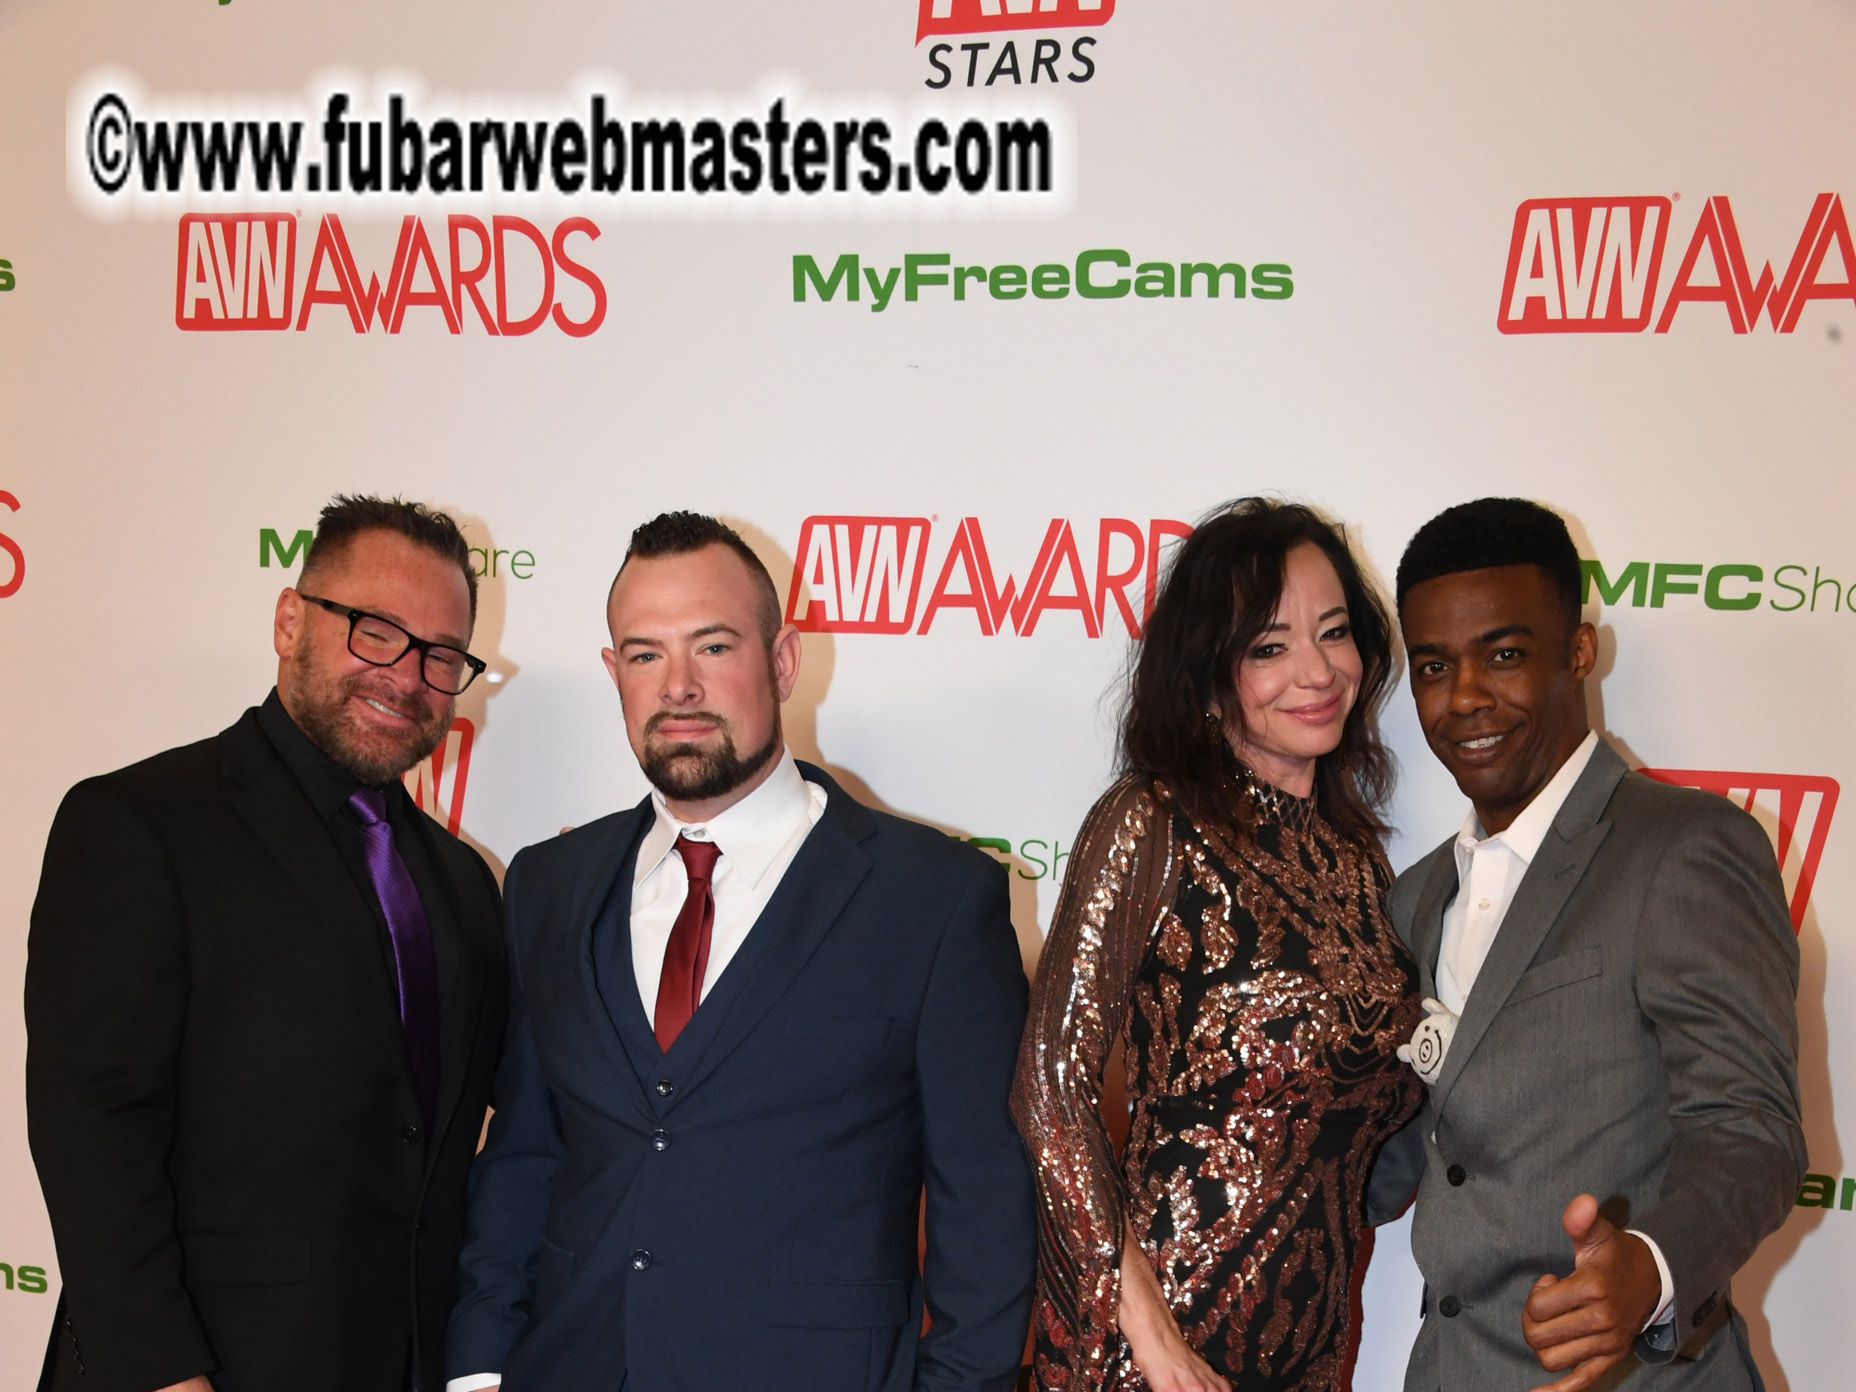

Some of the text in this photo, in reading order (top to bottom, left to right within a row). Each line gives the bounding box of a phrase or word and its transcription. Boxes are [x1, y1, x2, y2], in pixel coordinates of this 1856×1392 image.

[924, 36, 1097, 89] STARS
[180, 213, 607, 338] AVN AWARDS
[792, 248, 1294, 312] MyFreeCams
[1505, 204, 1663, 323] AVN
[790, 522, 924, 626] AVN
